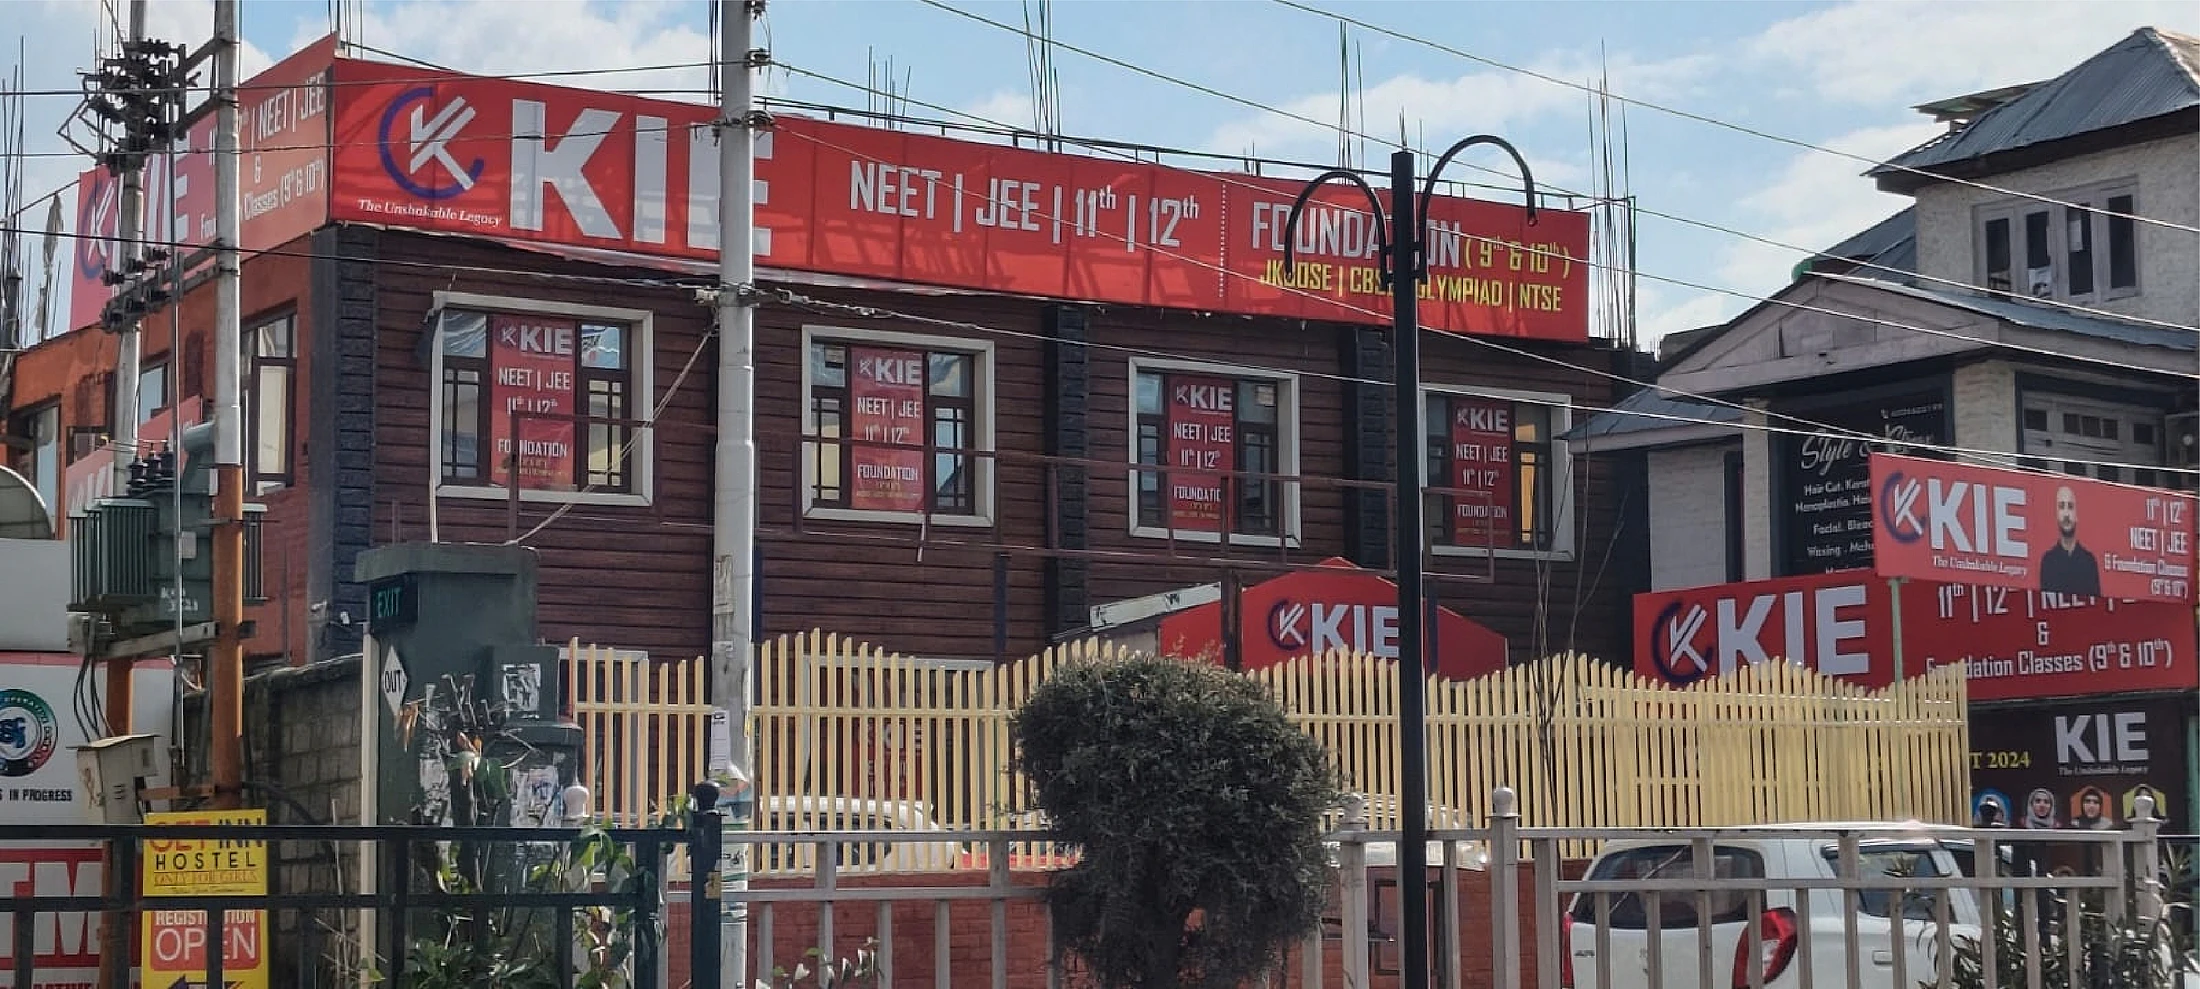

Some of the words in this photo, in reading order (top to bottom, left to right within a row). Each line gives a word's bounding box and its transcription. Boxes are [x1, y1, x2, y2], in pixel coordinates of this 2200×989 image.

[259, 88, 290, 142] NEET
[300, 71, 326, 120] JEE
[510, 98, 774, 257] KIE
[358, 199, 382, 213] The
[385, 201, 458, 220] Unshakable
[460, 210, 502, 227] Legacy
[850, 160, 943, 220] NEET
[975, 177, 1041, 232] JEE
[1074, 184, 1117, 238] 11th
[1149, 195, 1200, 248] 12th
[1252, 201, 1461, 269] FOUNDAON
[1350, 266, 1394, 297] CBS
[1518, 282, 1563, 311] NTSE
[521, 325, 573, 355] KIE
[498, 367, 533, 388] NEET
[545, 372, 571, 391] JEE
[875, 356, 922, 386] KIE
[857, 396, 889, 416] NEET
[898, 401, 921, 419] JEE
[1190, 384, 1233, 411] KIE
[1173, 421, 1201, 441] NEET
[1211, 425, 1232, 443] JEE
[1470, 408, 1510, 432] KIE
[498, 439, 567, 458] FONDATION
[1456, 443, 1481, 463] NEET
[1490, 445, 1508, 463] JEE
[1801, 427, 1853, 475] Style
[857, 463, 919, 482] FOUNDATION
[1173, 485, 1221, 503] FOUNDATIO
[1804, 483, 1825, 496] Hair
[1456, 503, 1508, 519] FOUNDAION
[1927, 478, 2029, 558] KIE
[2129, 526, 2157, 551] NEET
[2166, 530, 2189, 554] JEE
[2112, 554, 2157, 575] Foundation
[2158, 558, 2189, 577] Classes
[377, 587, 403, 618] EXIT
[1939, 583, 1965, 618] 11th
[1986, 586, 2018, 615] 12
[1311, 602, 1399, 658] KIE
[1717, 585, 1870, 680] KIE
[2037, 621, 2050, 647] &
[1926, 655, 2014, 680] Fdation
[2018, 650, 2083, 676] Classes
[2119, 643, 2131, 669] &
[384, 669, 402, 694] OUT
[2055, 712, 2150, 763] KIE
[1987, 751, 2031, 769] 2024
[9, 788, 19, 801] IN
[22, 788, 73, 802] PROGRESS
[218, 816, 263, 849] INN
[156, 852, 256, 870] HOSTEL
[155, 910, 256, 925] REGISTTION
